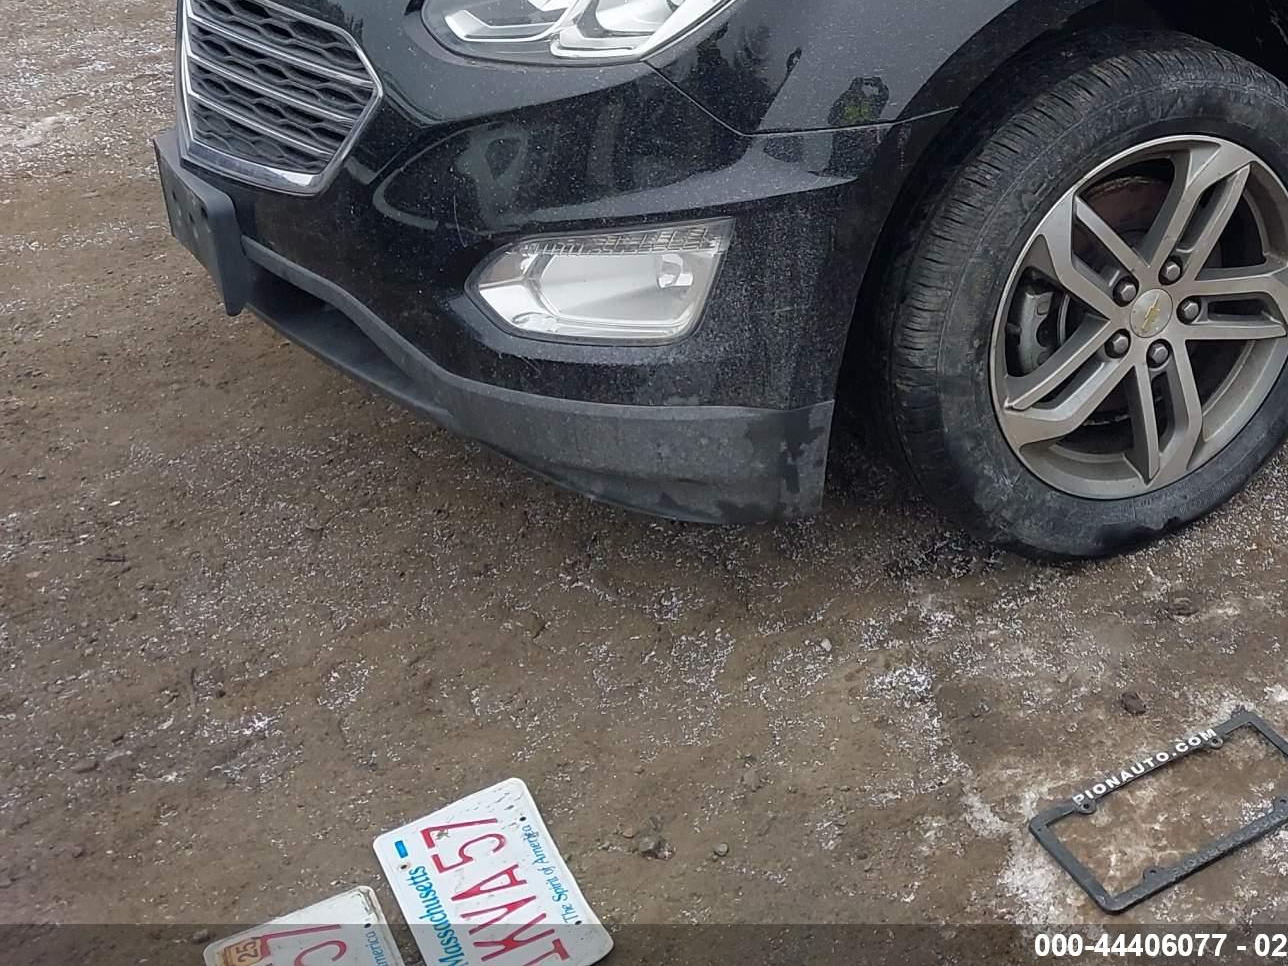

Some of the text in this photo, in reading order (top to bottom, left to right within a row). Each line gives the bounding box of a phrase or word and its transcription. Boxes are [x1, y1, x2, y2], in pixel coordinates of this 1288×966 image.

[1072, 728, 1217, 804] PIONAUTO.COM
[521, 825, 578, 924] The Spirit of America
[238, 937, 259, 963] 25
